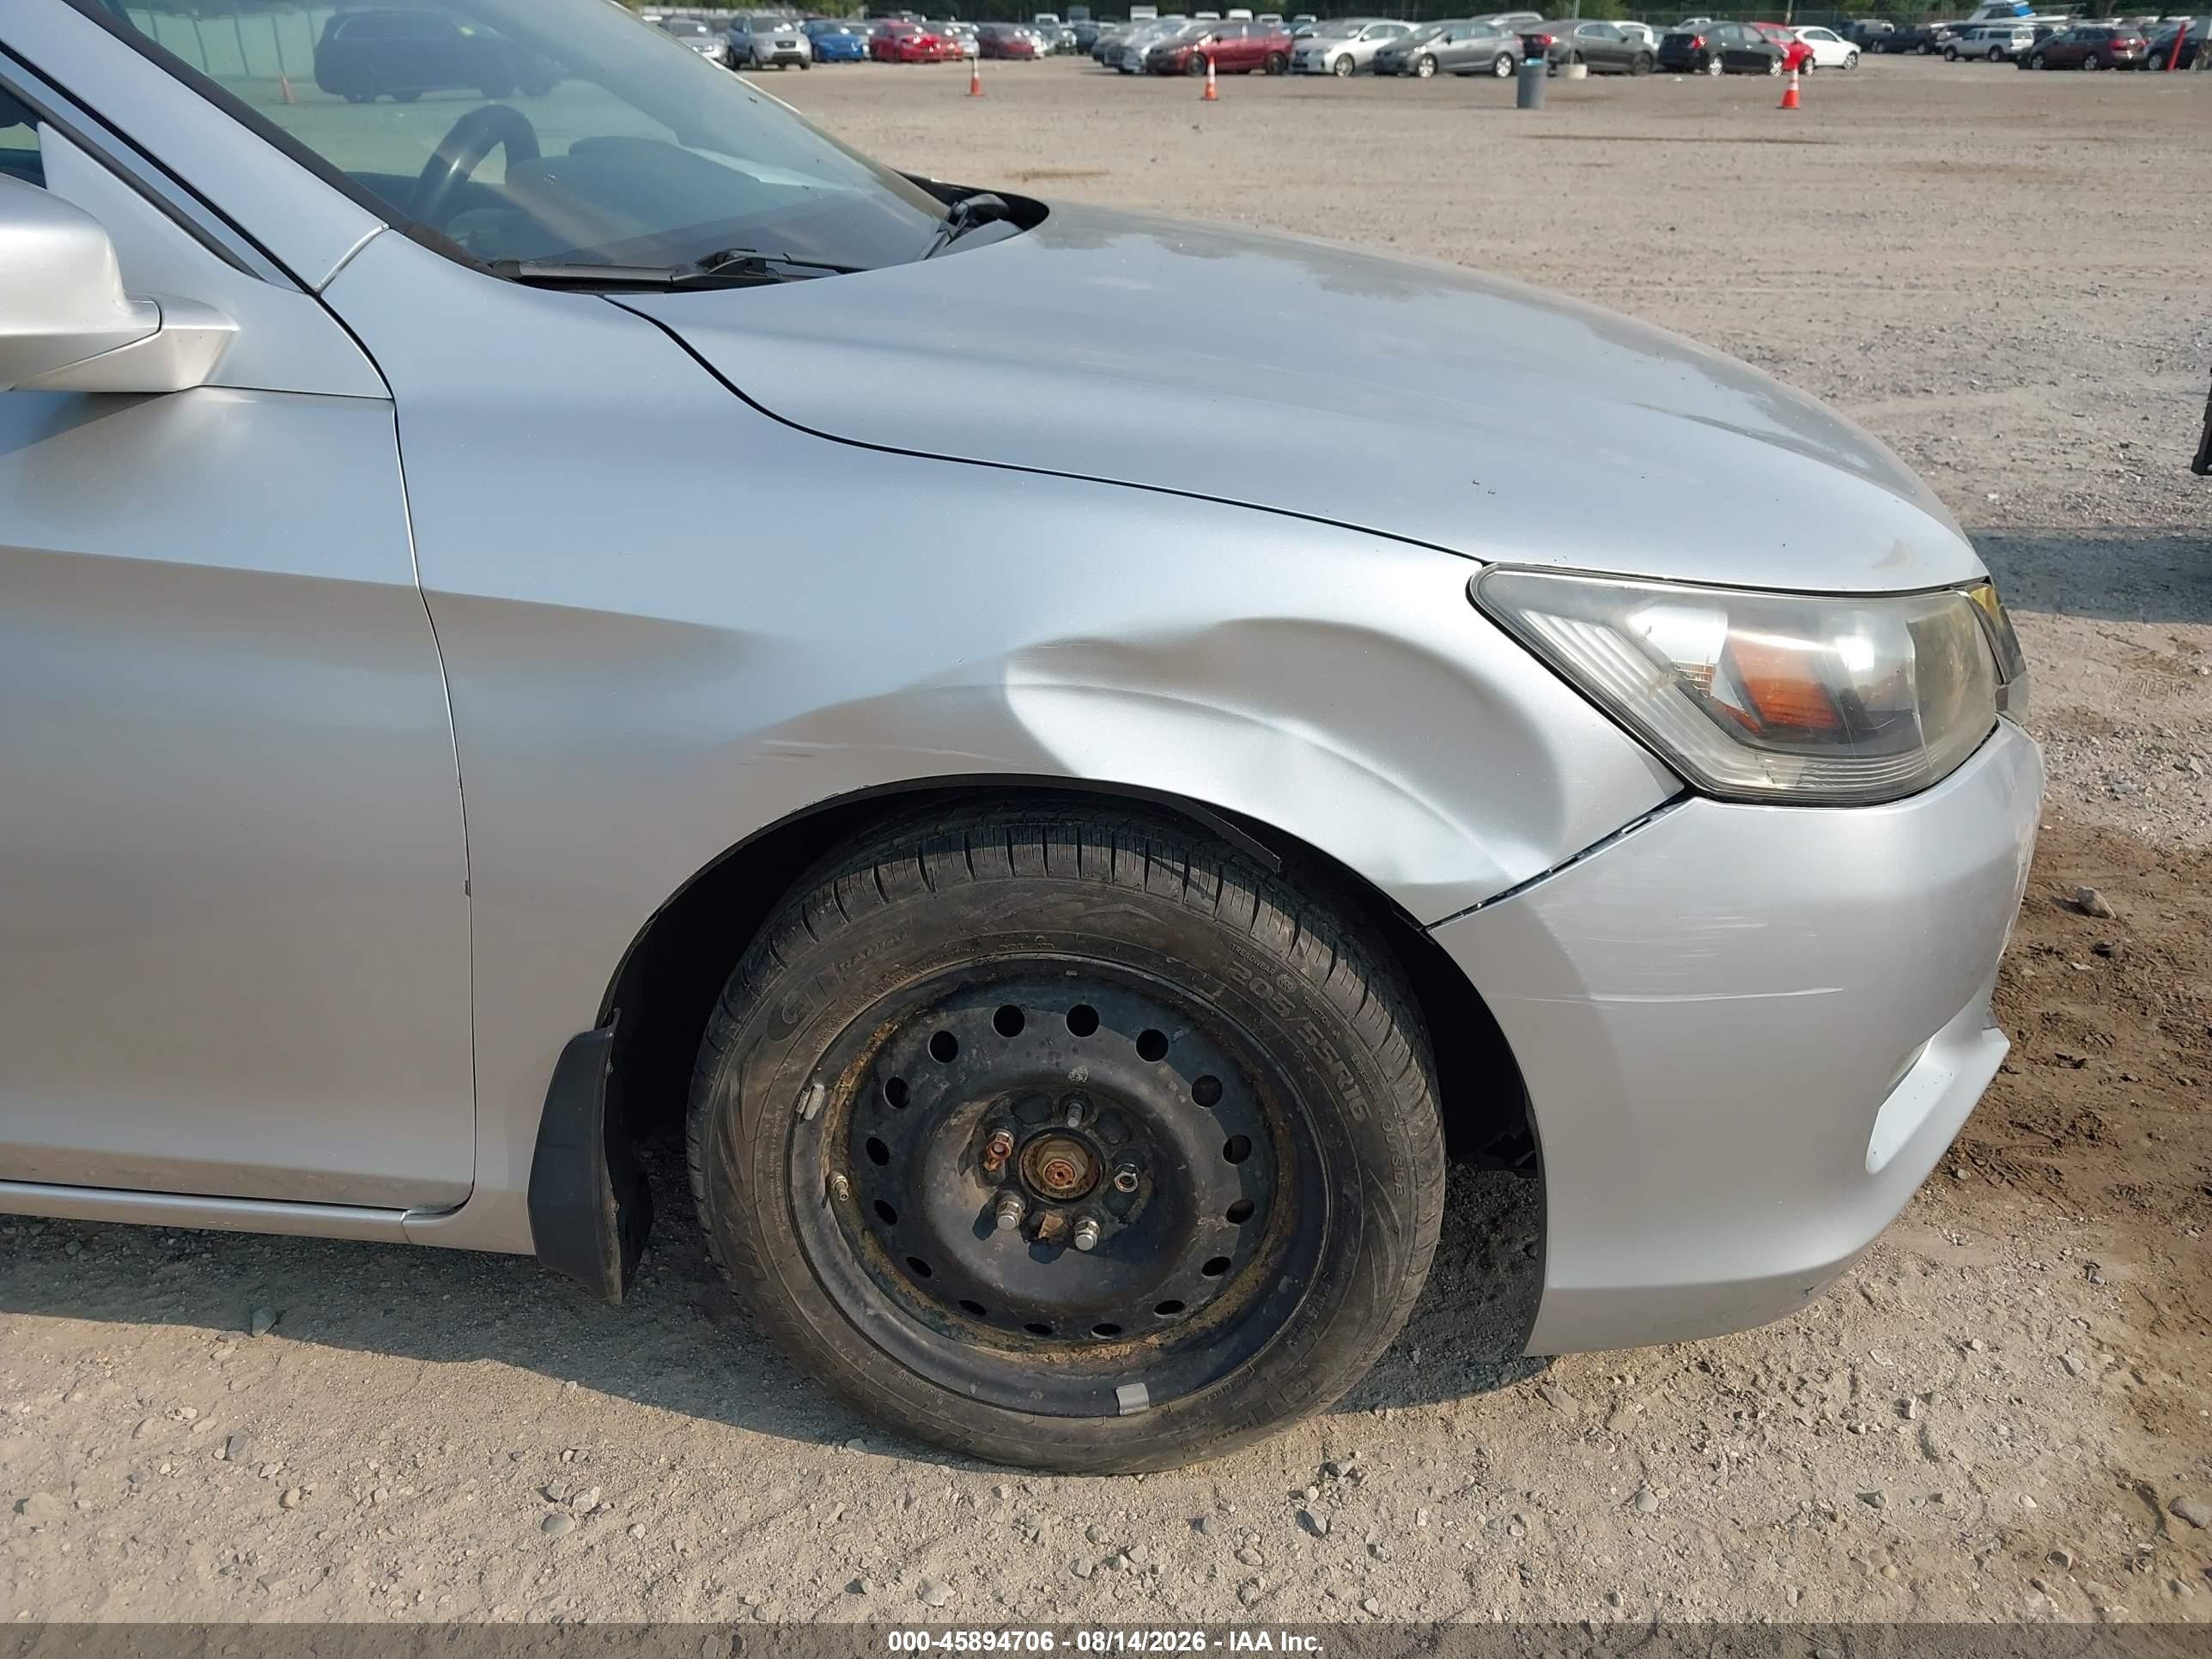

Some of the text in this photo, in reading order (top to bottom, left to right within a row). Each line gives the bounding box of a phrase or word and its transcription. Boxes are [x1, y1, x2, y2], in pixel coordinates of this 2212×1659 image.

[1230, 944, 1277, 977] TREADWEAR
[1225, 959, 1373, 1121] 205/55R16
[1381, 1118, 1405, 1197] OUTSIDE
